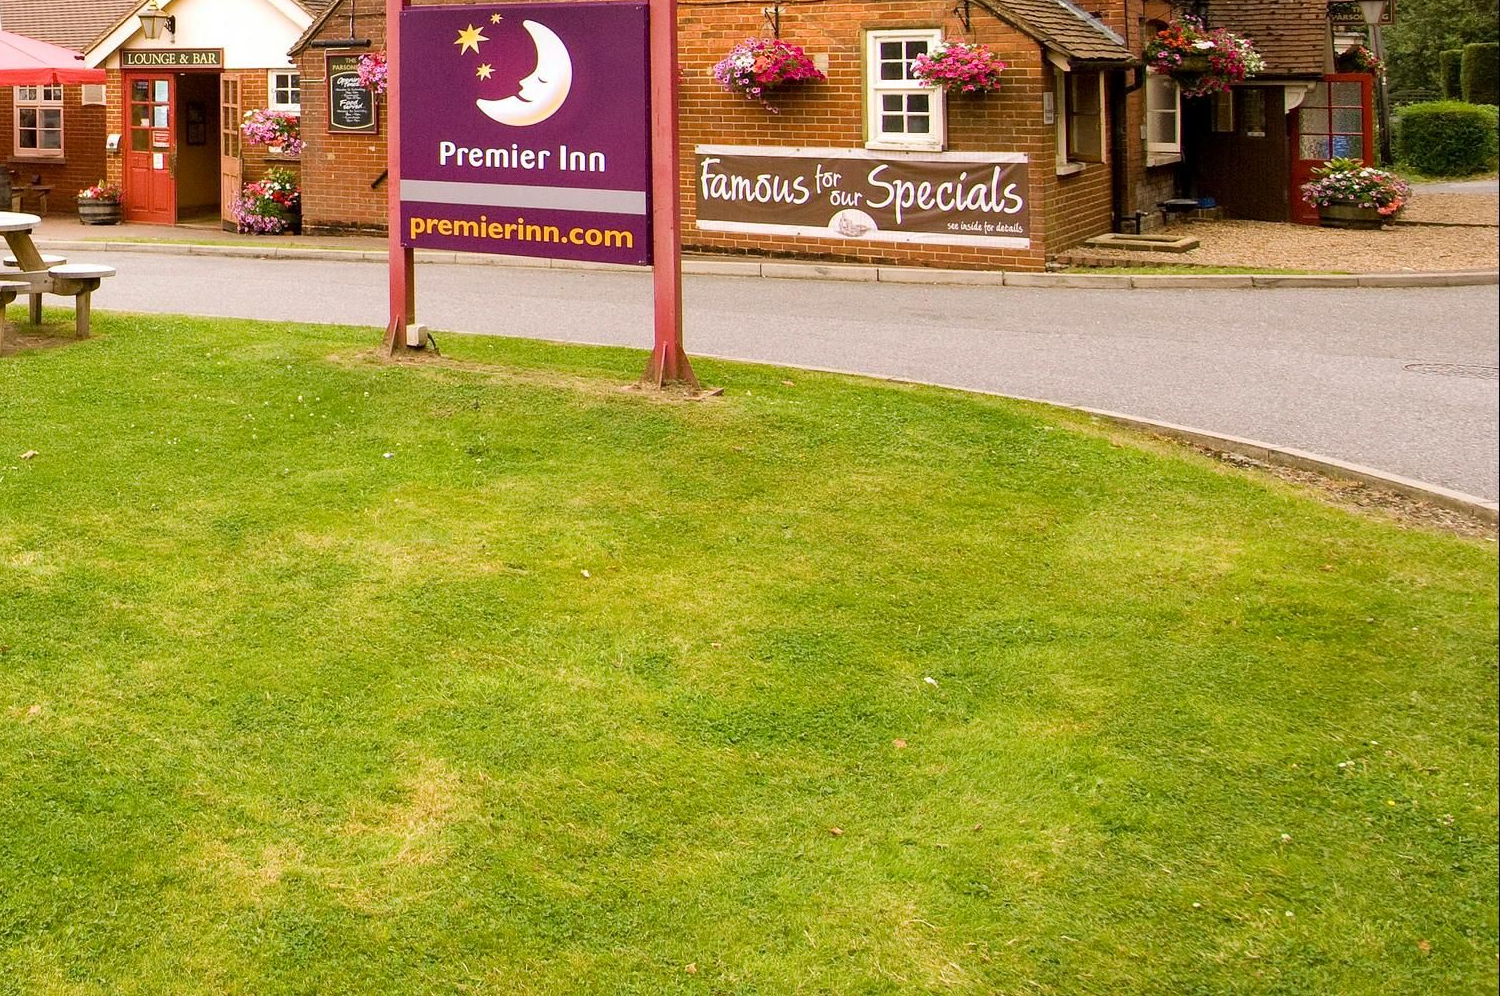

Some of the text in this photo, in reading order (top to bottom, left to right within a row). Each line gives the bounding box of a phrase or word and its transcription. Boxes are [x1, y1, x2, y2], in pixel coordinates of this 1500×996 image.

[127, 52, 217, 65] LOUNGE & BAR
[439, 141, 606, 173] Premier Inn
[700, 156, 843, 205] Famous for
[830, 164, 1024, 225] our Specials
[410, 215, 633, 248] premierinn.com
[947, 220, 1024, 235] see inside for details
